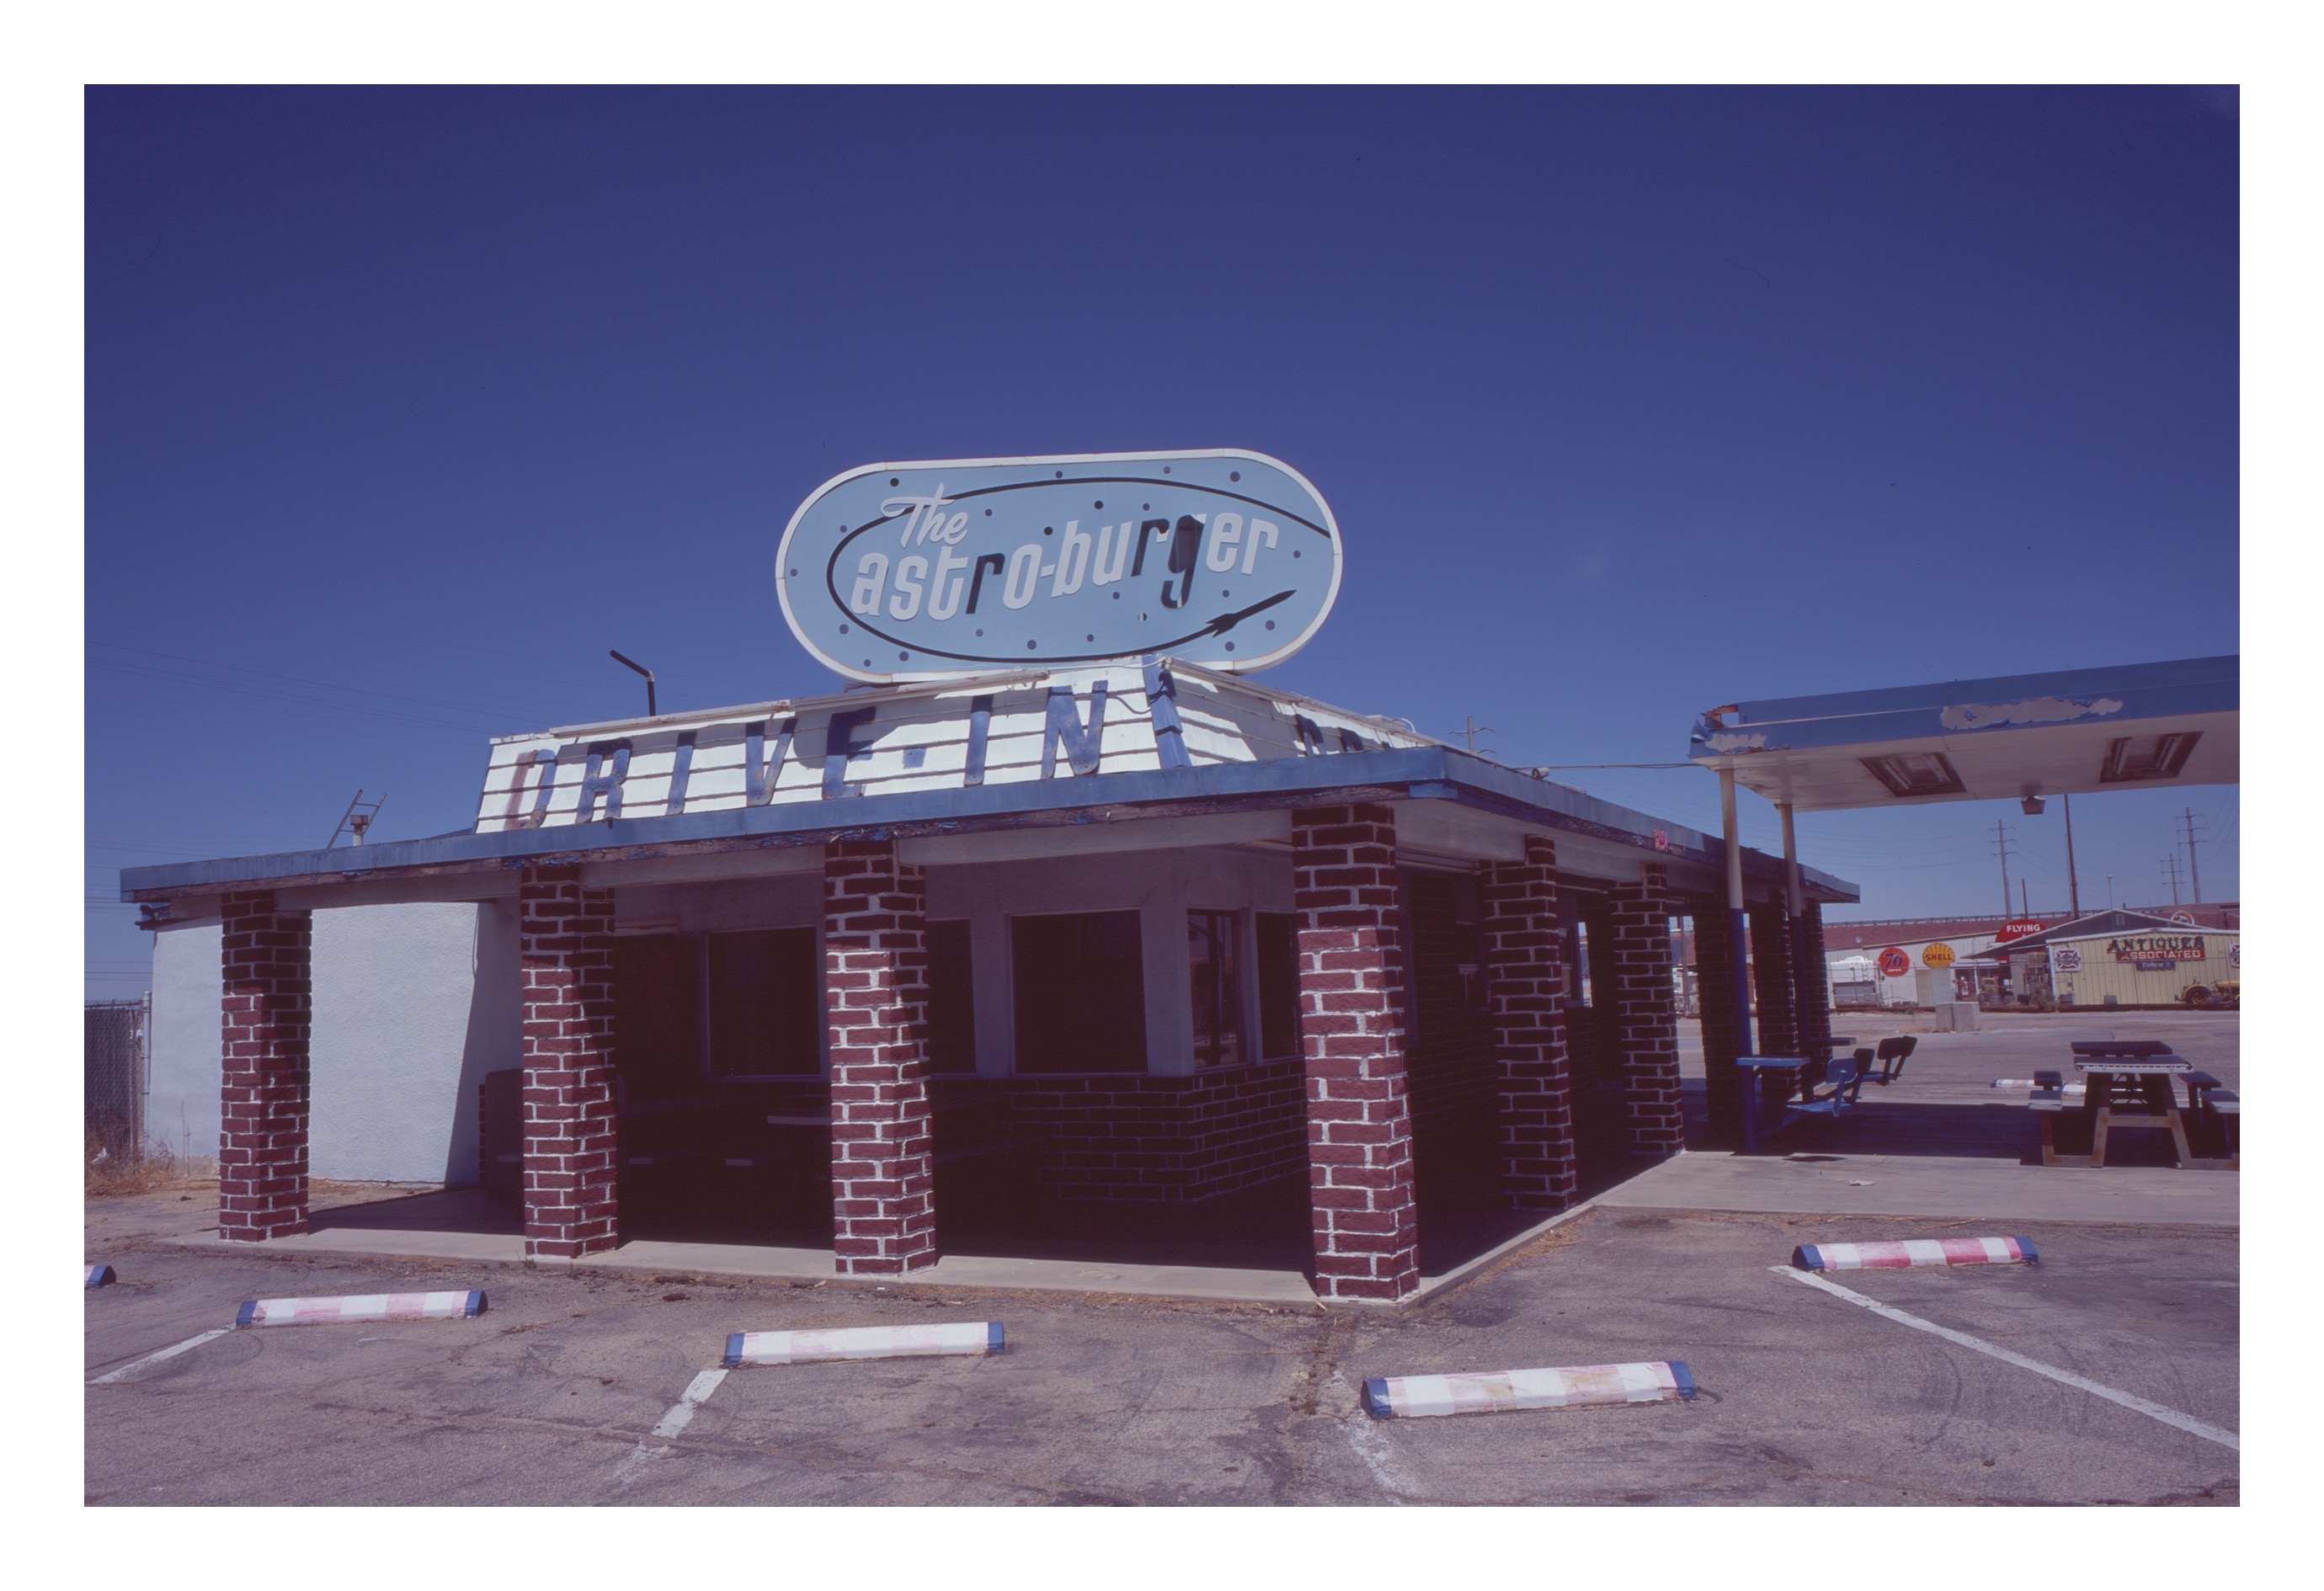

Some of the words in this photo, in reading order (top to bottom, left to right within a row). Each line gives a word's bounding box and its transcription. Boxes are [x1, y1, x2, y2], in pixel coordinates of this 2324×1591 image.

[880, 482, 968, 549] The
[2007, 923, 2040, 933] FLYING
[1884, 952, 1903, 968] 76
[1925, 953, 1953, 961] SHELL
[2120, 949, 2201, 960] ASSOCIATED
